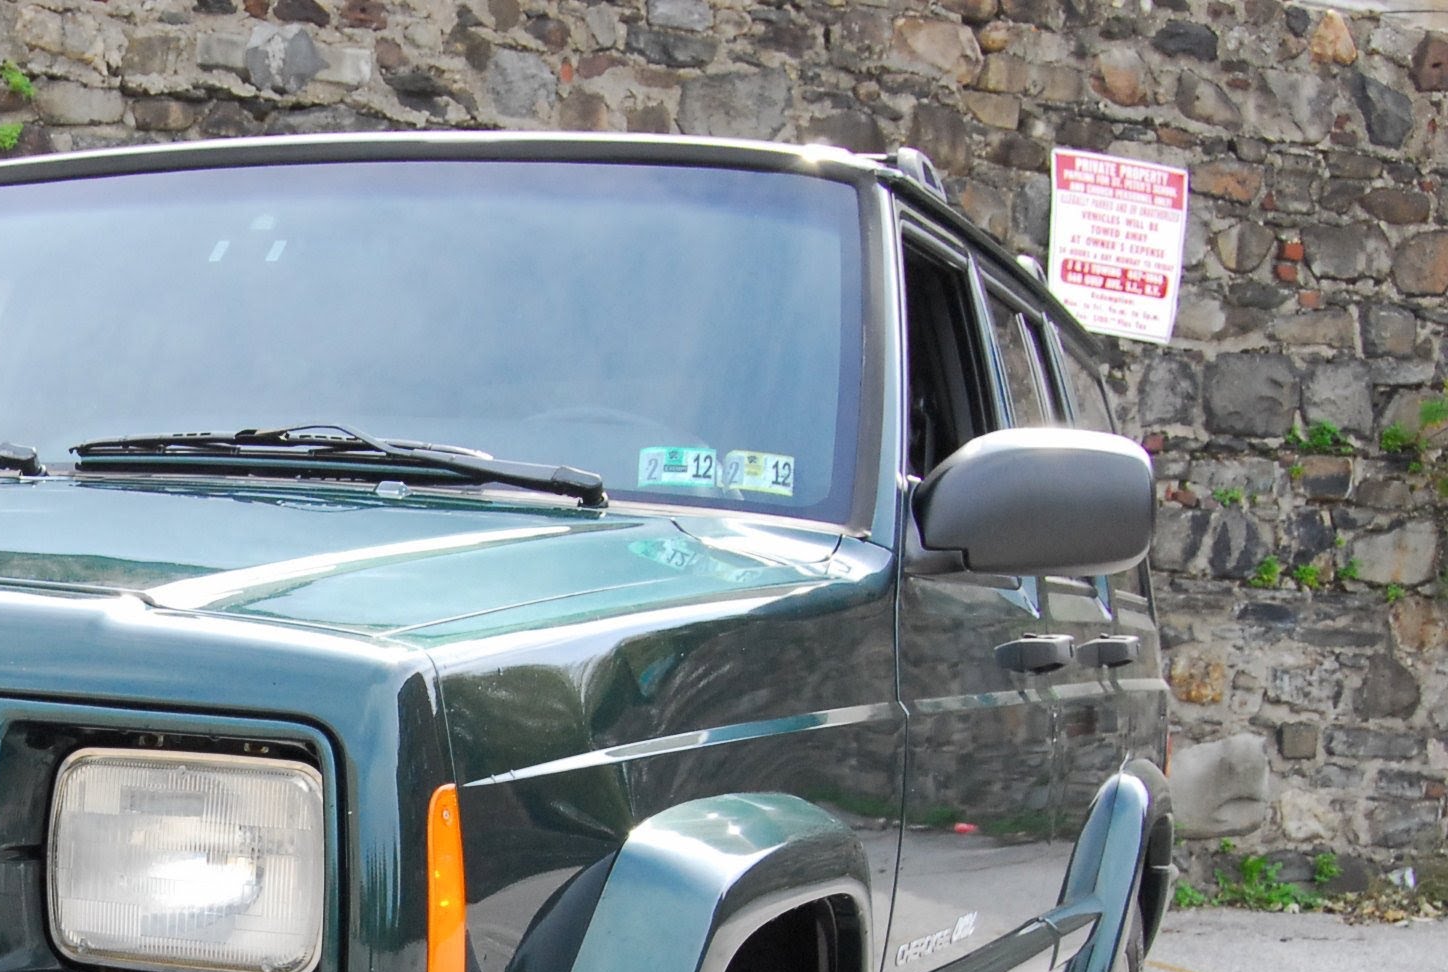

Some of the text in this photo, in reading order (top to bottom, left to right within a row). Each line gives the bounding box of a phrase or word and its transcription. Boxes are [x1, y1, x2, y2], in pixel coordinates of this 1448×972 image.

[1076, 157, 1169, 185] PRIVATE PROPERTY
[1082, 210, 1159, 231] VEHICLES WILL BE
[1091, 225, 1148, 242] TOWED AWAY
[1070, 248, 1090, 258] HOURS
[1101, 253, 1112, 261] DAY
[1116, 256, 1141, 266] MONDAY
[1071, 235, 1080, 245] AT
[1130, 244, 1165, 258] EXPENSE
[647, 459, 659, 481] 2
[692, 454, 713, 479] 12
[727, 462, 740, 484] 2
[772, 461, 792, 487] 12
